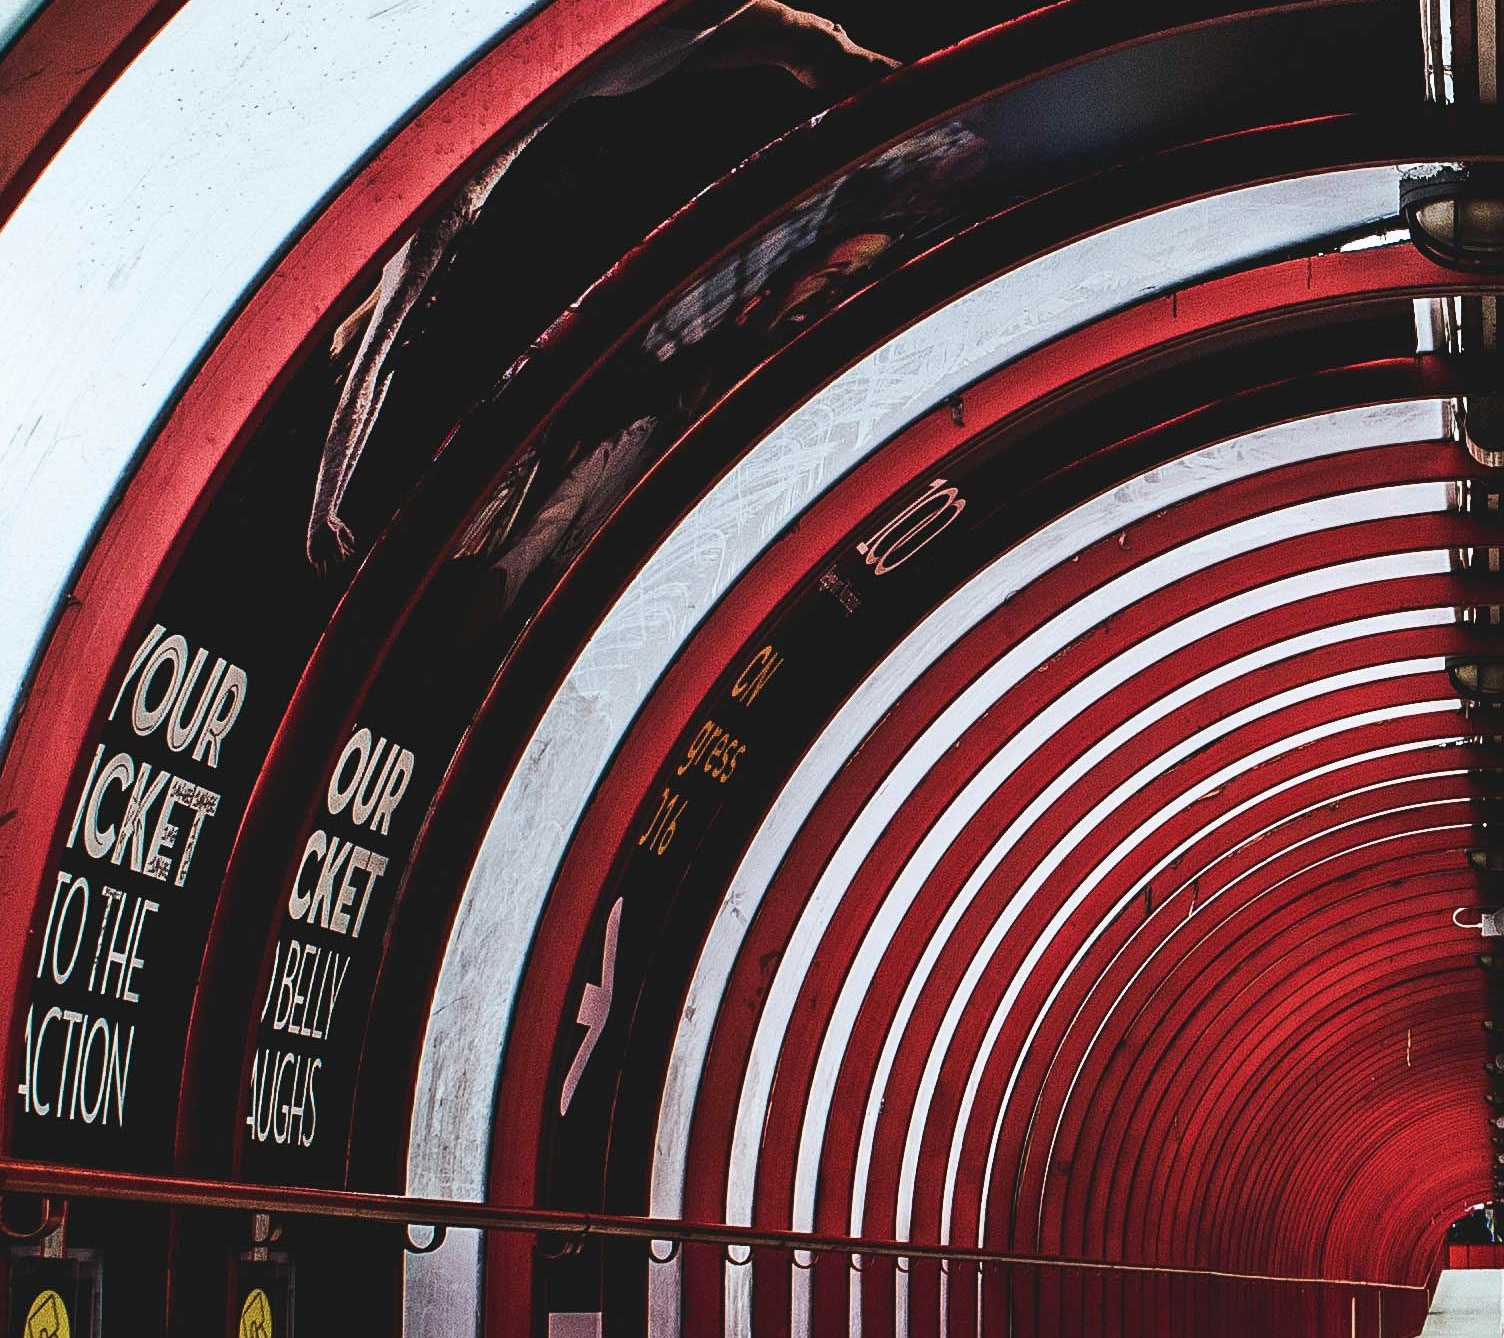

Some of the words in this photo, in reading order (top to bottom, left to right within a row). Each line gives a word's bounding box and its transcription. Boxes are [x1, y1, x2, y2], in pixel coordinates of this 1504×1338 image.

[677, 719, 746, 782] gress
[37, 871, 90, 985] TO
[88, 886, 160, 1002] THE
[273, 940, 351, 1041] BELLY
